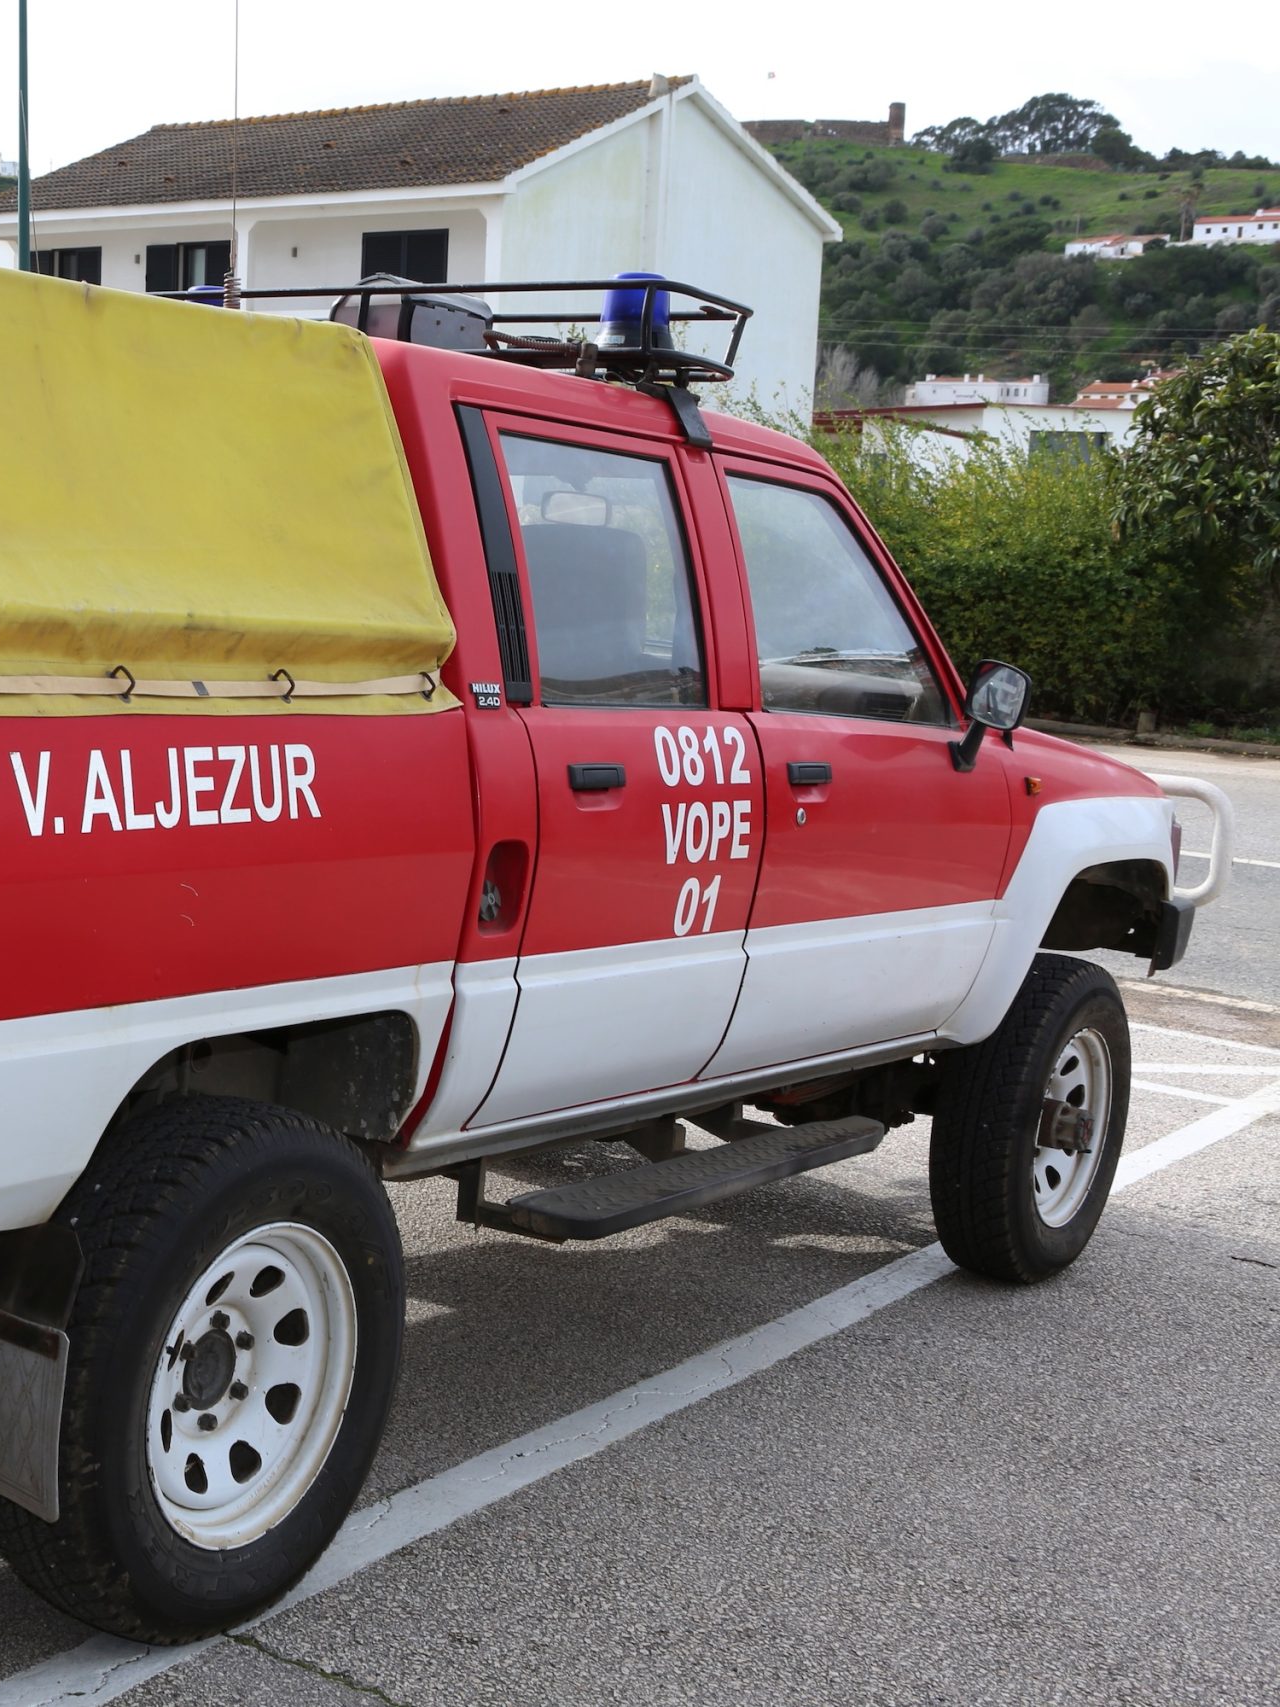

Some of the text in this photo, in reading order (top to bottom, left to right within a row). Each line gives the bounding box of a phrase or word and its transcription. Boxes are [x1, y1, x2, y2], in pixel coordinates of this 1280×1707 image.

[471, 682, 501, 694] HILUX
[653, 725, 752, 787] 0812
[9, 750, 65, 837] V.
[80, 743, 323, 834] ALJEZUR
[661, 799, 752, 865] VOPE
[672, 874, 722, 938] 01
